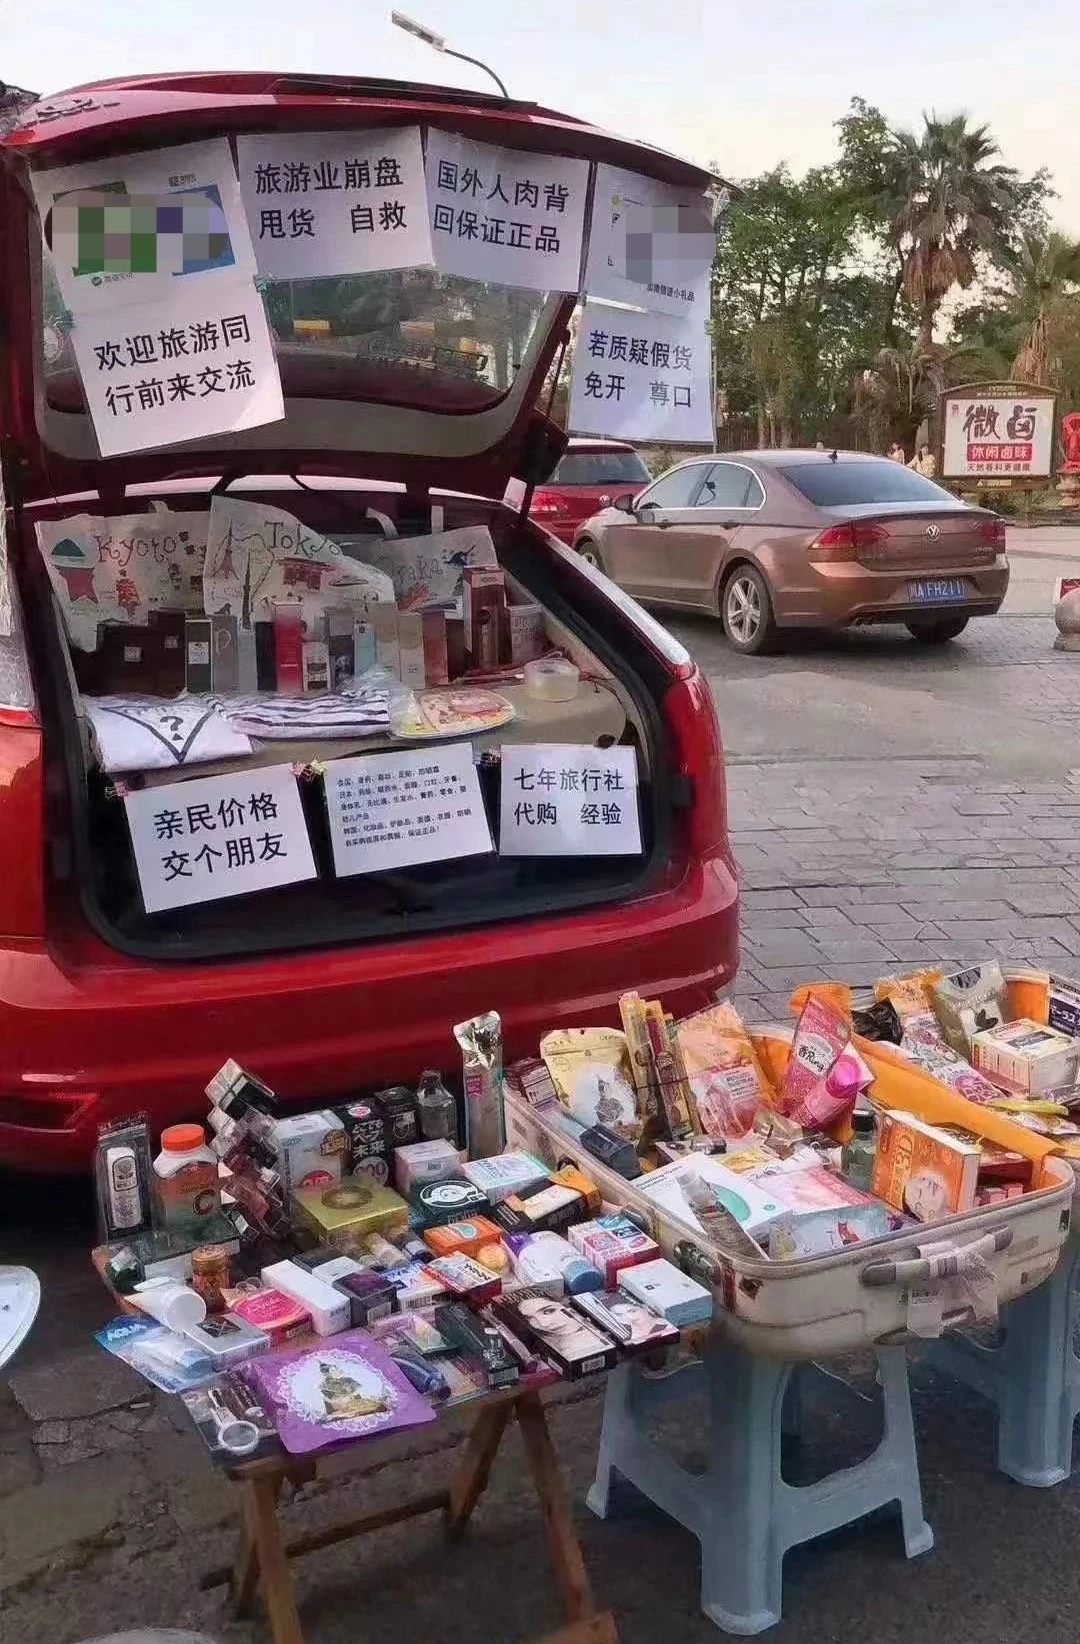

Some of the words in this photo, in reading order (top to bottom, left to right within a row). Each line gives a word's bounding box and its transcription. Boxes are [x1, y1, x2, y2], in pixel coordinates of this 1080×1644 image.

[255, 157, 403, 194] 旅游业崩盘
[437, 159, 570, 213] 国外人肉背
[259, 208, 316, 239] 甩货
[350, 200, 407, 233] 自救
[433, 204, 561, 253] 回保证正品
[95, 314, 251, 371] 欢迎旅游同
[588, 330, 692, 371] 若质疑假货
[105, 360, 256, 416] 行前来交流
[583, 370, 626, 401] 免开
[649, 381, 692, 408] 尊口
[93, 535, 176, 566] Kyoto
[514, 767, 624, 792] 七年旅行社
[154, 792, 278, 840] 亲民价格
[514, 802, 557, 826] 代购
[581, 802, 622, 825] 经验
[161, 832, 287, 881] 交个朋友
